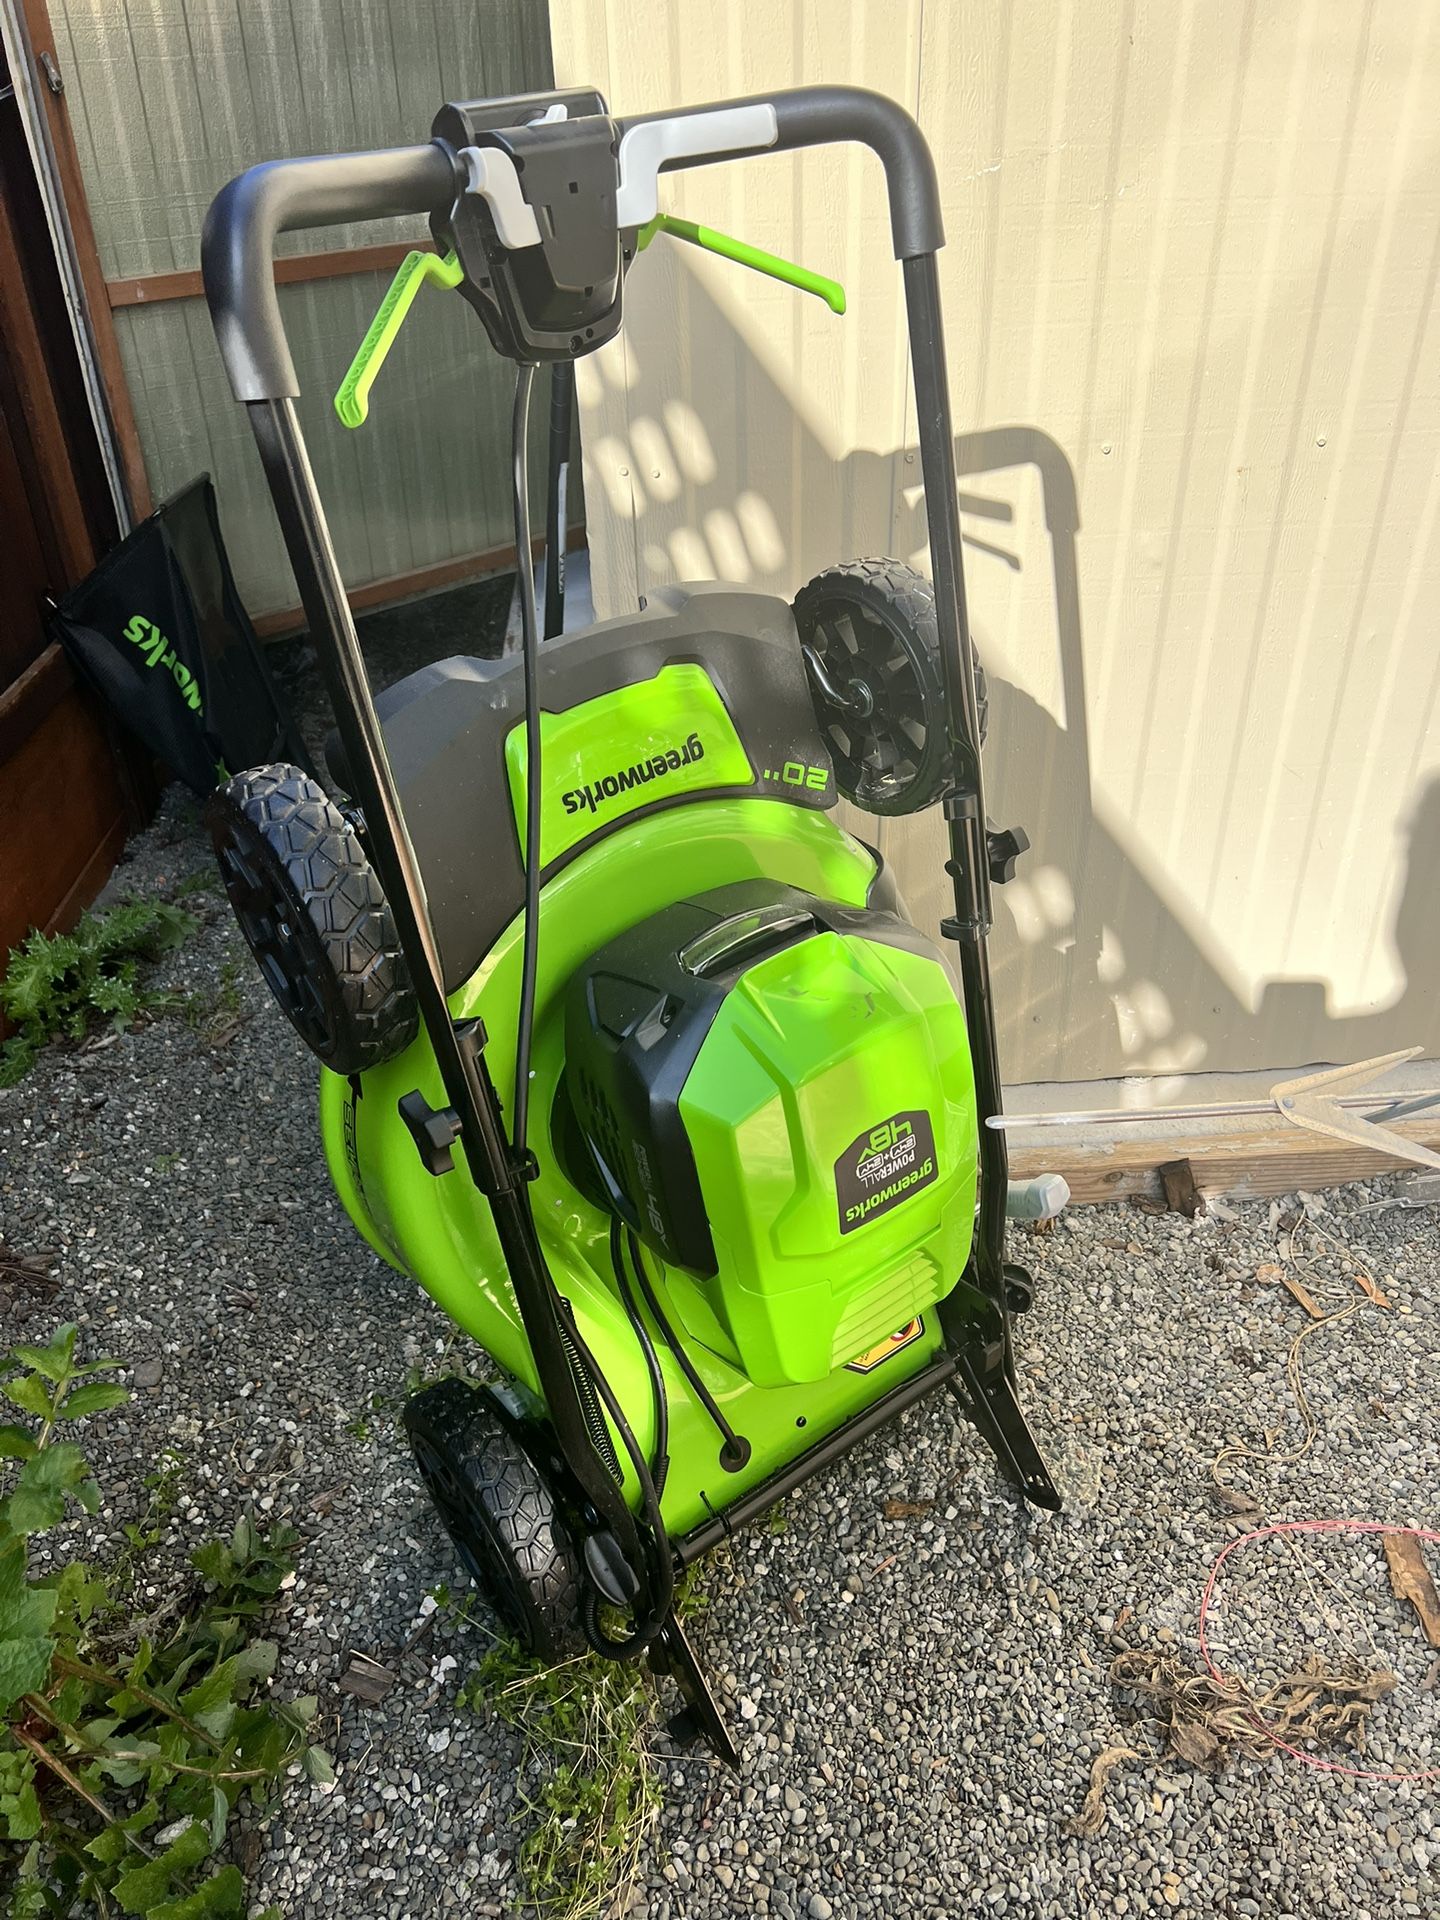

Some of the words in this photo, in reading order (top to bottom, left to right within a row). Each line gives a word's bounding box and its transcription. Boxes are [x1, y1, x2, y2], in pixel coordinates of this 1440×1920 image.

[561, 732, 705, 815] greenworks
[857, 1120, 913, 1164] 48V
[860, 1149, 915, 1189] POWERALL
[845, 1157, 934, 1222] greenworks
